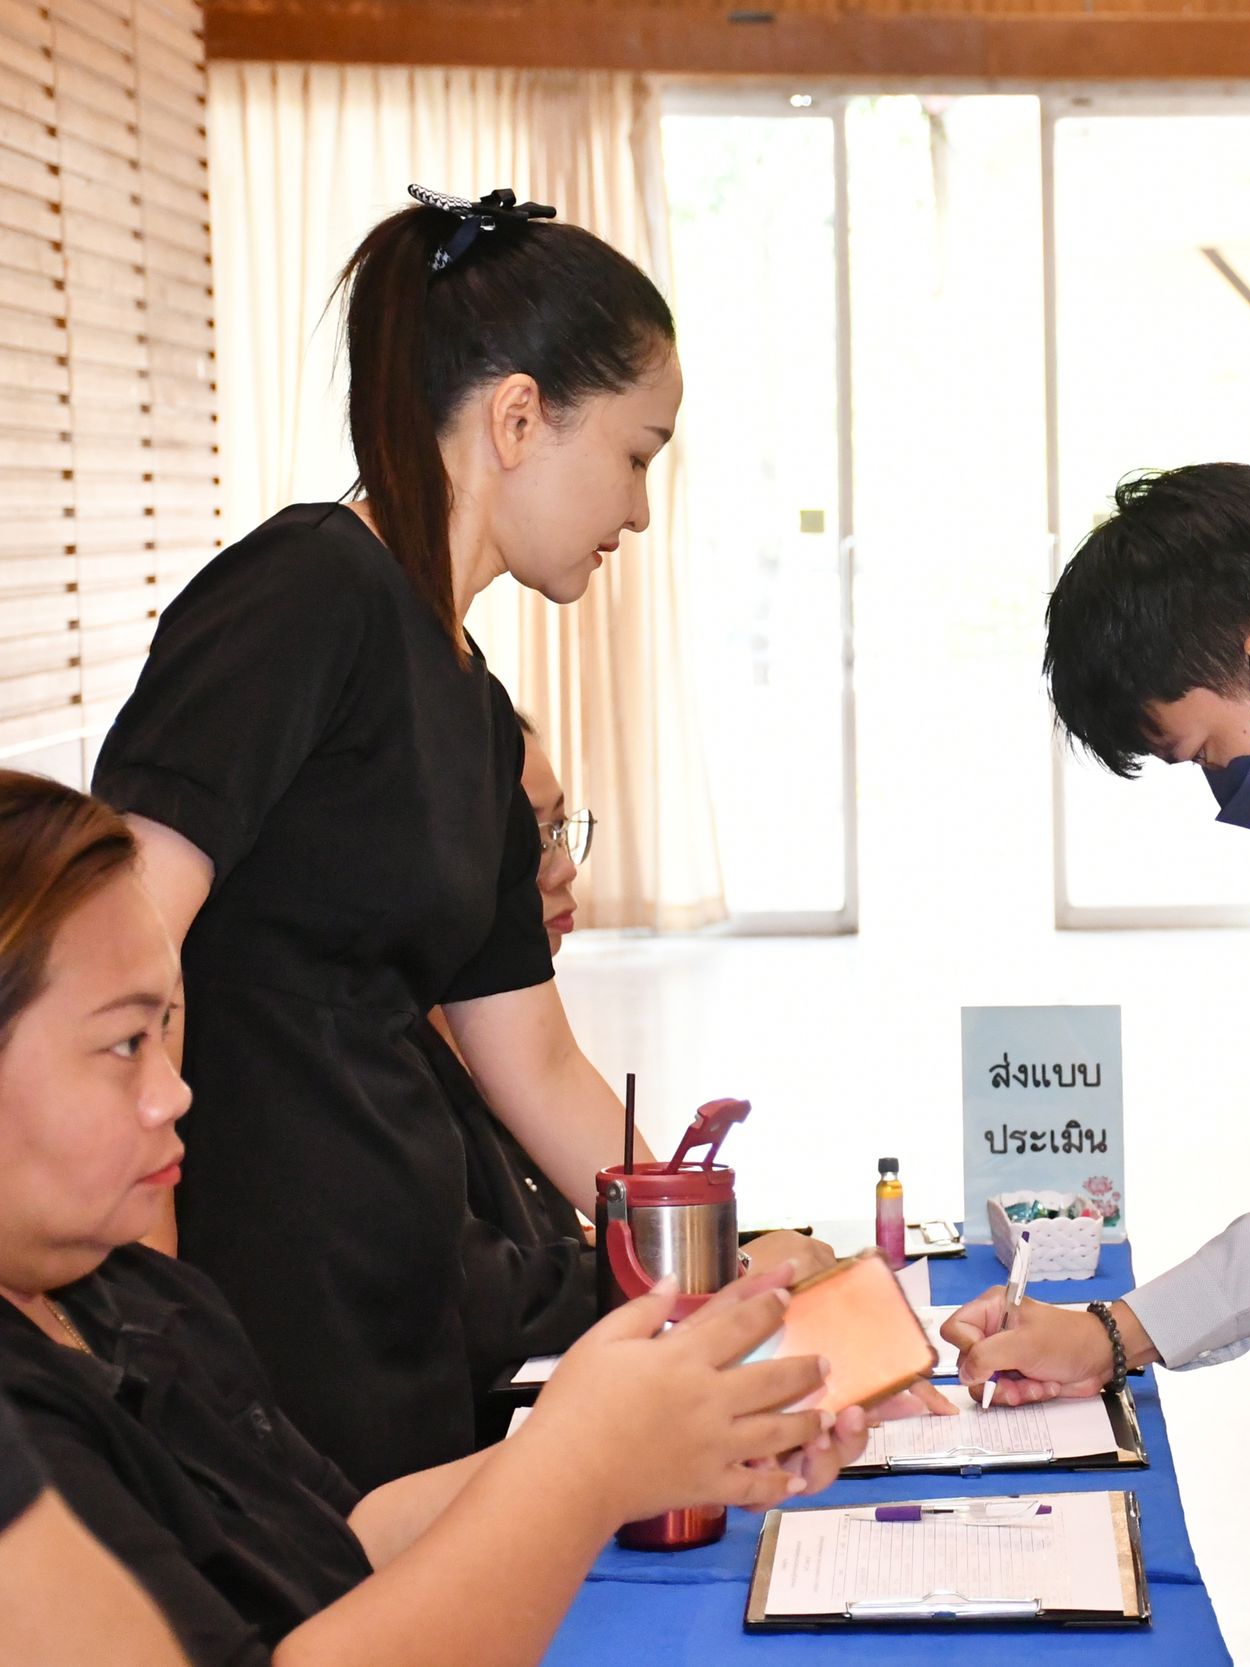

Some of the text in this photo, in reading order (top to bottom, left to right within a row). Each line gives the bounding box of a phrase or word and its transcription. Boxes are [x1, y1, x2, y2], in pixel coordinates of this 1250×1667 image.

[988, 1052, 1102, 1089] ส่งแบบ
[984, 1119, 1108, 1155] ประเมิน
